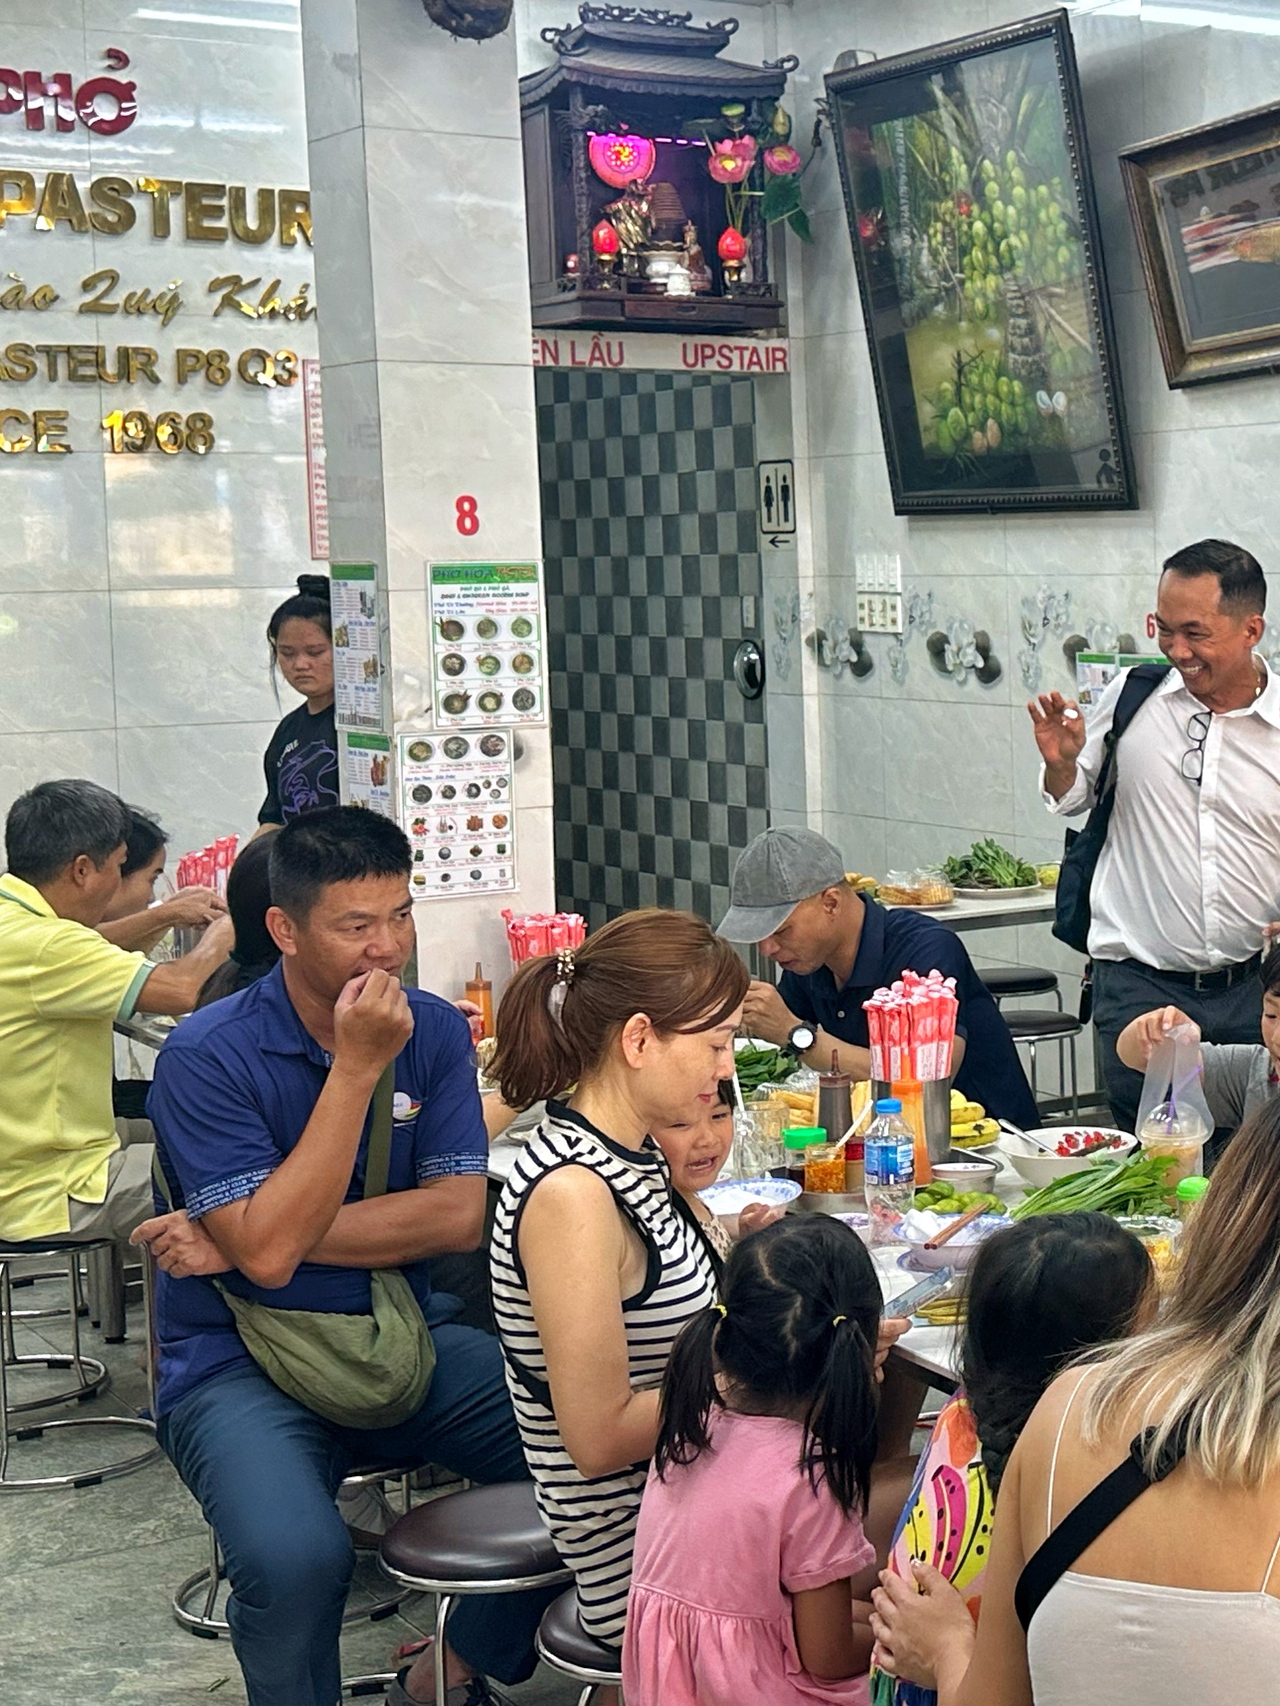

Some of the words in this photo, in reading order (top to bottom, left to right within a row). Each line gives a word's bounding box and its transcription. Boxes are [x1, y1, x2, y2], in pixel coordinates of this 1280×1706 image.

[0, 170, 313, 247] PASTEUR
[0, 343, 161, 384] STEUR
[571, 332, 624, 366] LẦU
[682, 342, 787, 371] UPSTAIR
[102, 409, 214, 454] 1968
[456, 495, 480, 536] 8
[1146, 614, 1155, 639] 6
